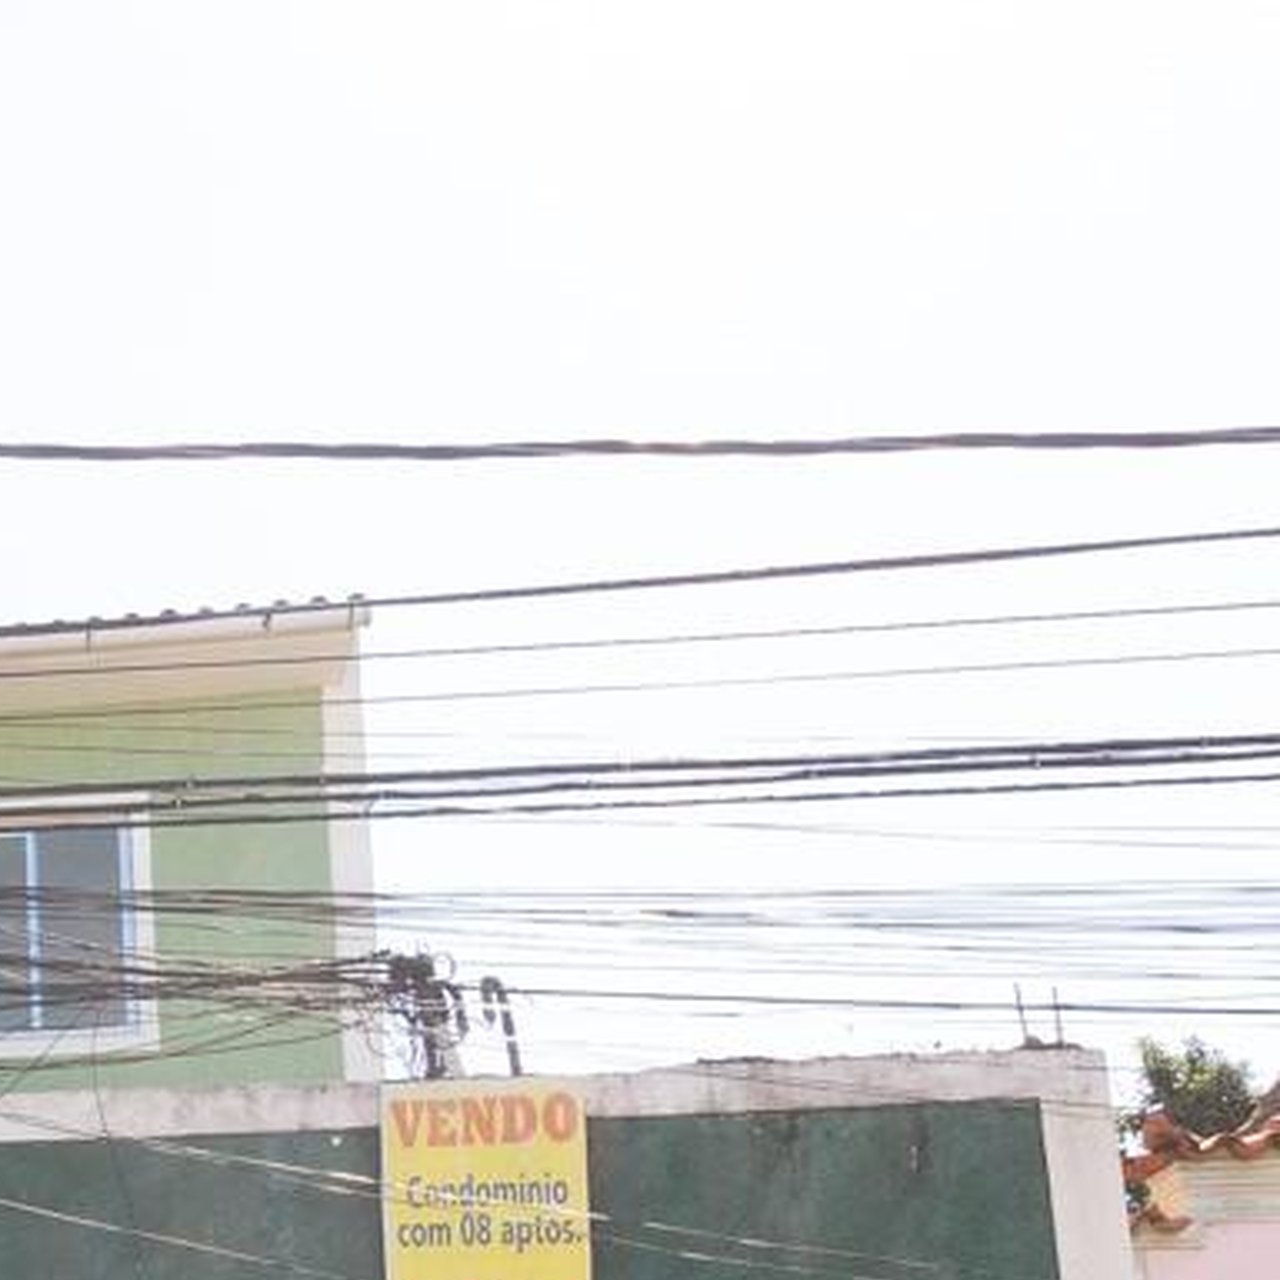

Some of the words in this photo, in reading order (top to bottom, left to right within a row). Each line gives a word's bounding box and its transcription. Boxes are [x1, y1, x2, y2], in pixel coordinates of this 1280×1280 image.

[391, 1092, 577, 1147] VENDO
[397, 1222, 452, 1247] com
[460, 1213, 492, 1246] 08
